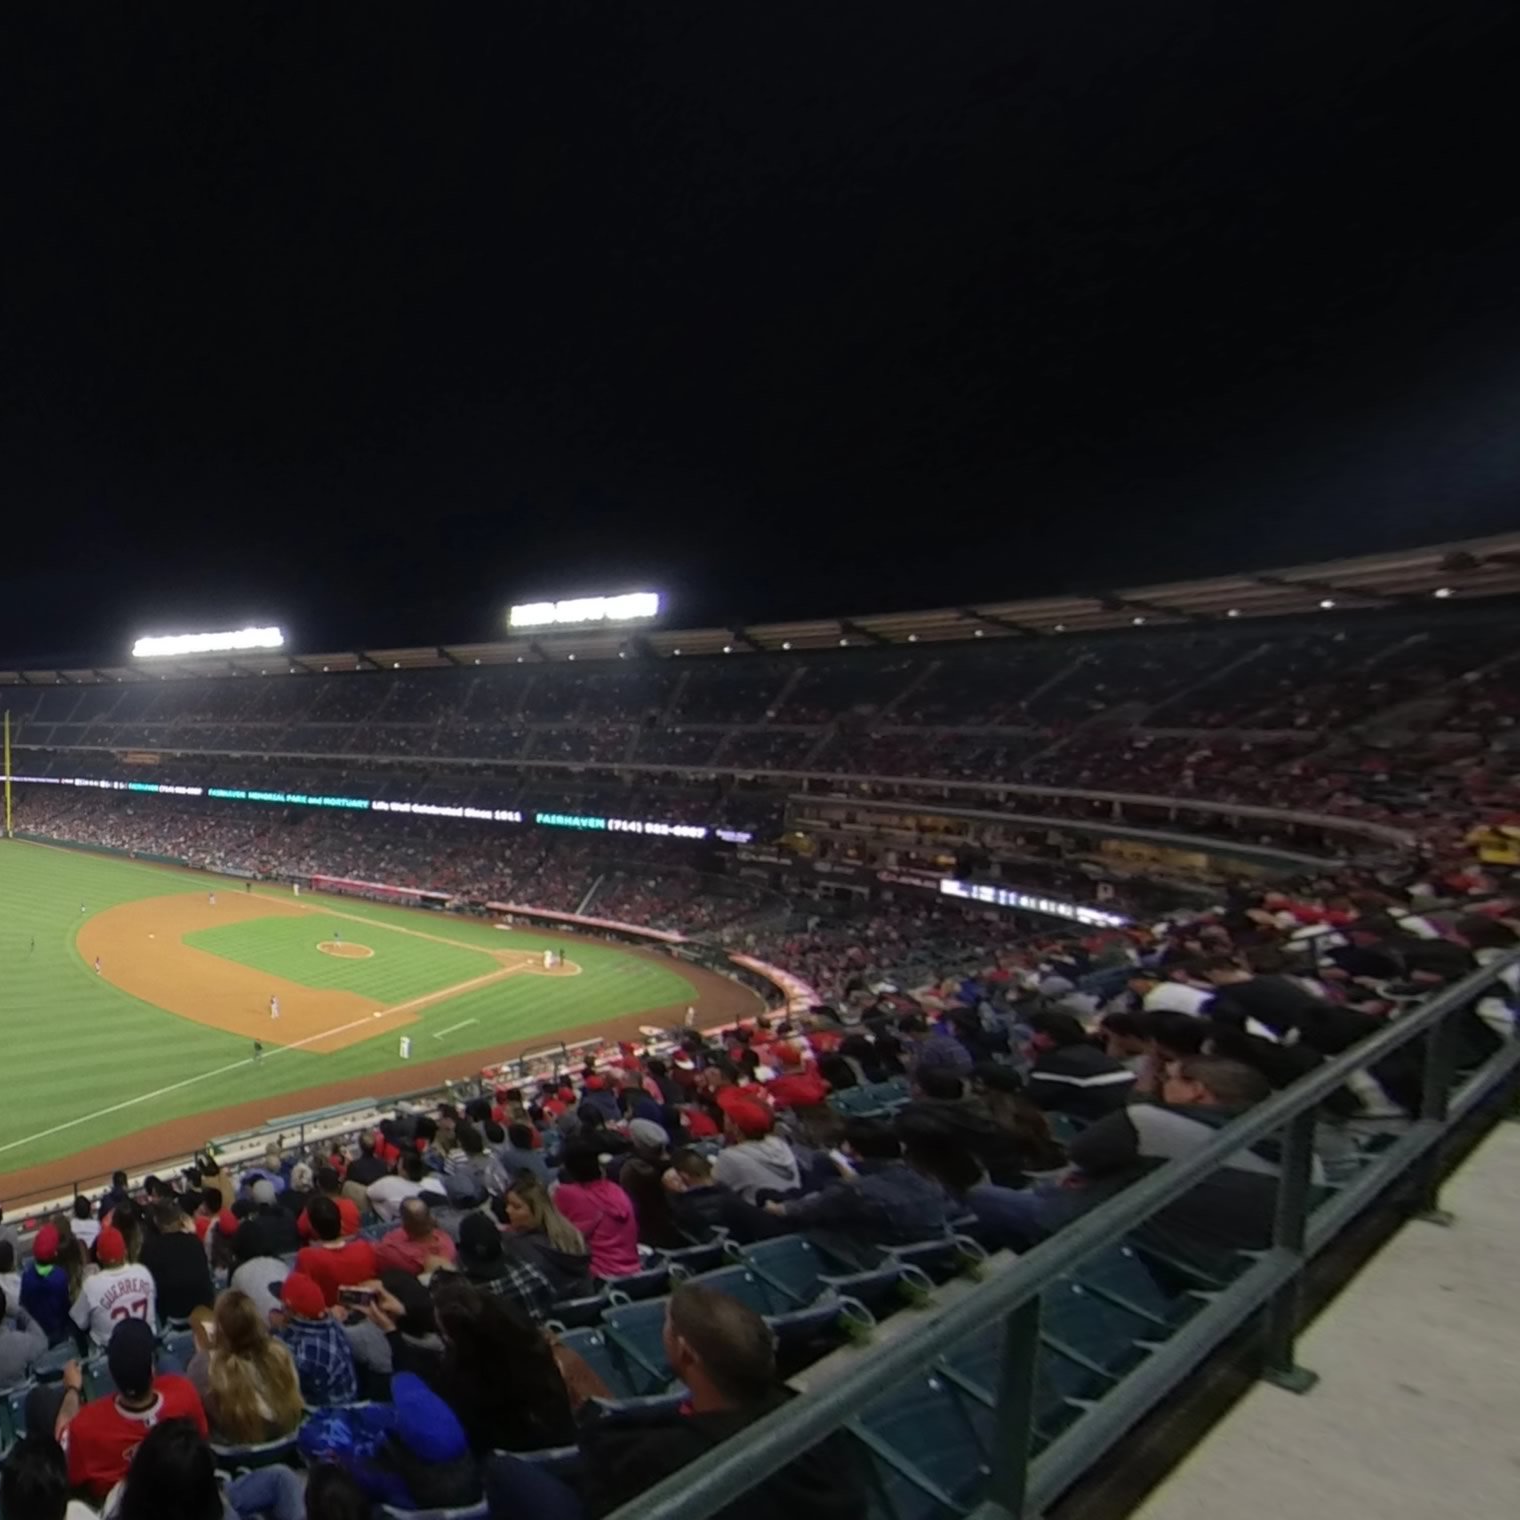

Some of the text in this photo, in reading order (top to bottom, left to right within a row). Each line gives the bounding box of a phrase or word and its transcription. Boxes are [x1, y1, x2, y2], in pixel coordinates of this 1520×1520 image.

[536, 813, 605, 831] FAIRHAVEN
[607, 818, 642, 833] (714)
[99, 1277, 151, 1311] GUERRERO
